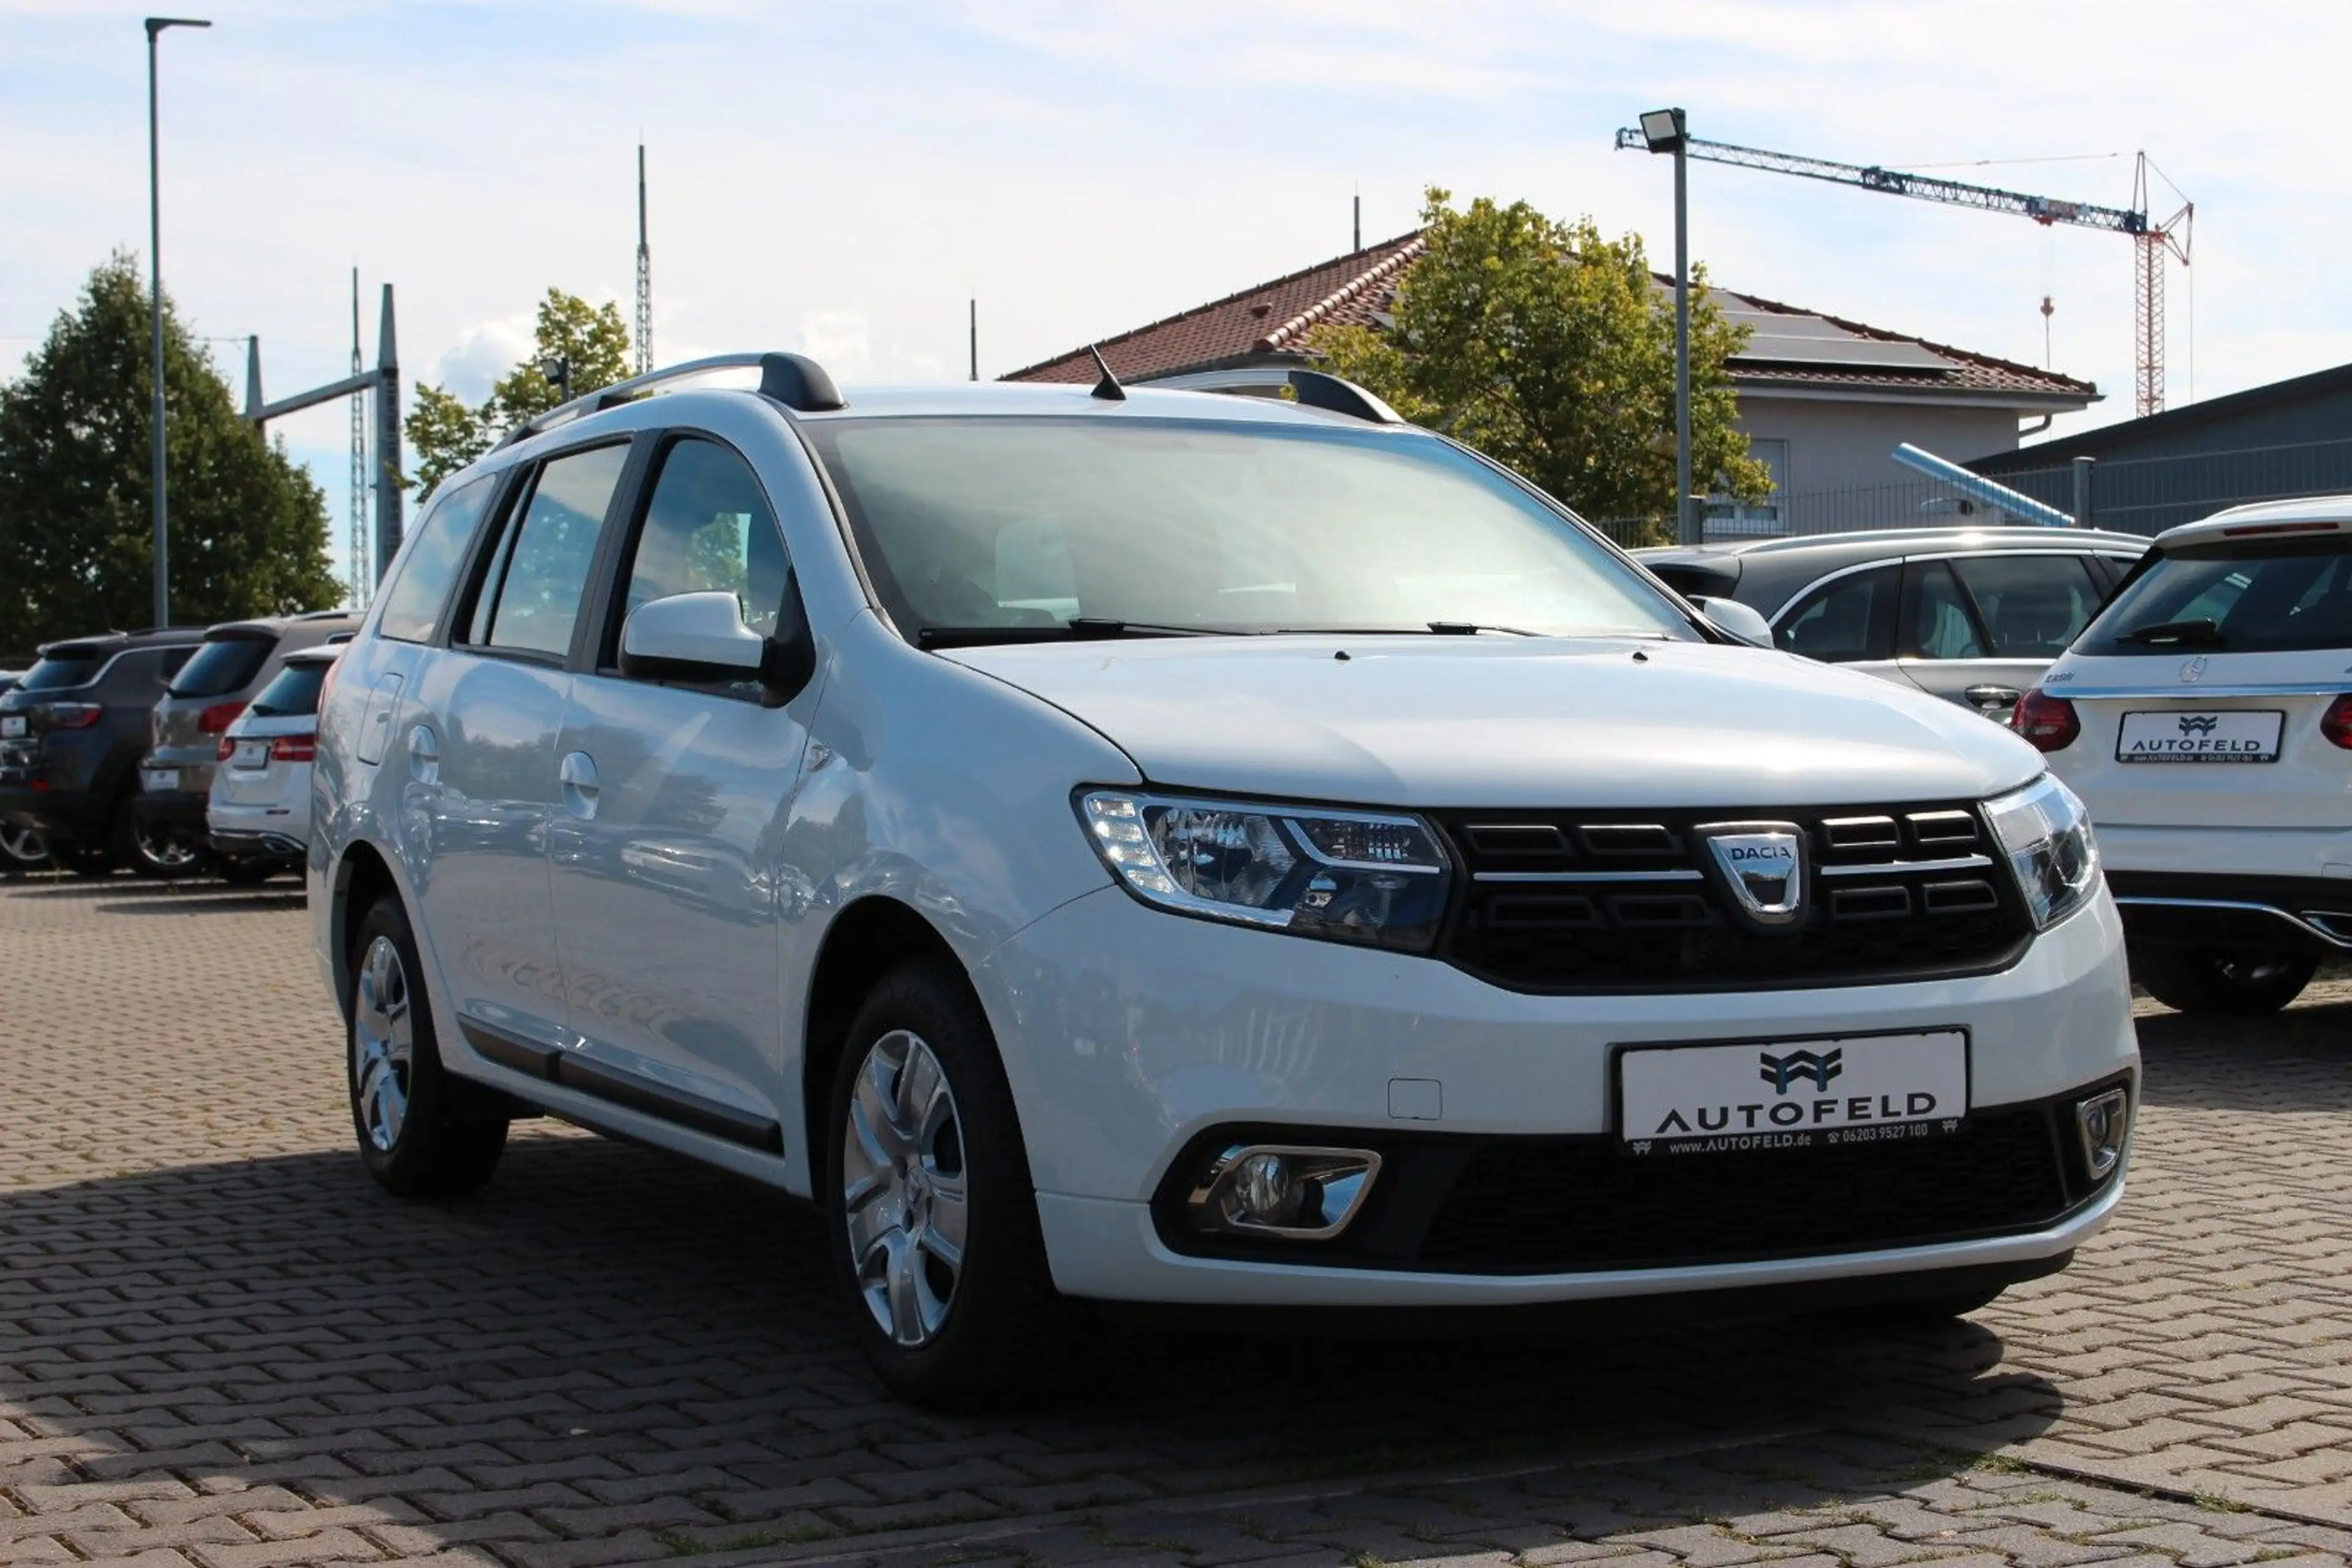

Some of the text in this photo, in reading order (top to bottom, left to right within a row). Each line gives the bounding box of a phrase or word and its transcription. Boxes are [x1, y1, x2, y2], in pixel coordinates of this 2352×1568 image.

[2132, 740, 2260, 752] AUTOFELD
[1731, 846, 1792, 859] DACIA
[1656, 1092, 1936, 1134] AUTOFELD
[1670, 1123, 1928, 1153] www.AUTOFELD.de 06203 9527 100
